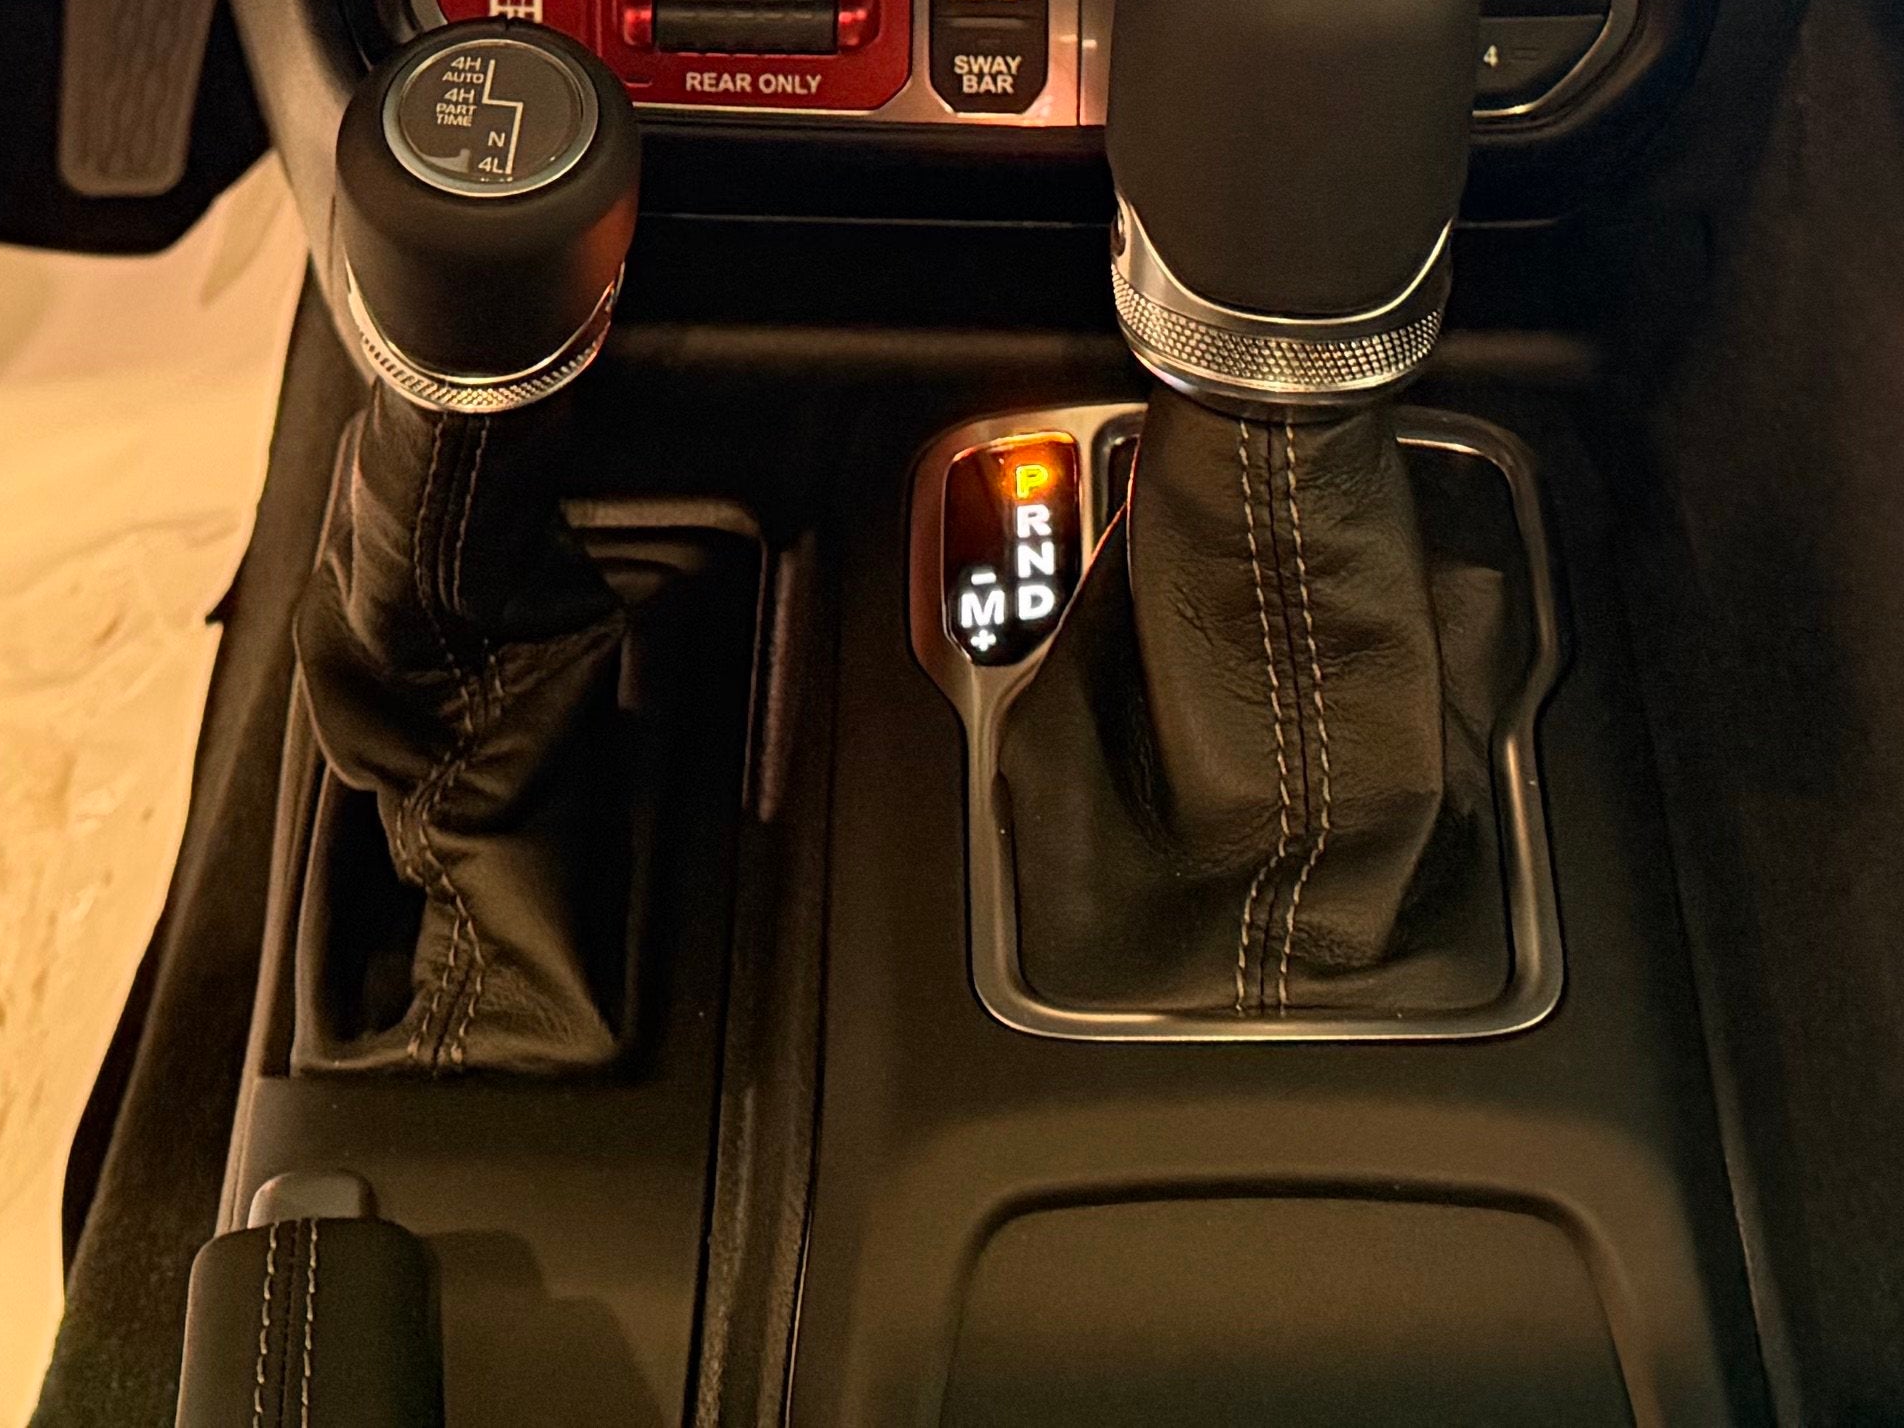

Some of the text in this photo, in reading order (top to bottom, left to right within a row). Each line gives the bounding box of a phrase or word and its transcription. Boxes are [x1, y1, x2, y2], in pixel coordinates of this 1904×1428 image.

[450, 56, 482, 71] 4H
[953, 55, 1022, 76] SWAY
[1483, 44, 1499, 67] 4
[442, 71, 484, 84] AUTO
[686, 72, 822, 95] REAR ONLY
[961, 73, 1014, 94] BAR
[443, 87, 475, 103] 4H
[436, 102, 477, 116] PART
[436, 114, 473, 128] TIME
[487, 131, 506, 148] N
[478, 156, 505, 174] 4L
[1015, 463, 1049, 500] P
[1016, 503, 1053, 538] R
[1016, 540, 1056, 579] N
[960, 588, 1006, 629] M
[1017, 583, 1056, 621] D
